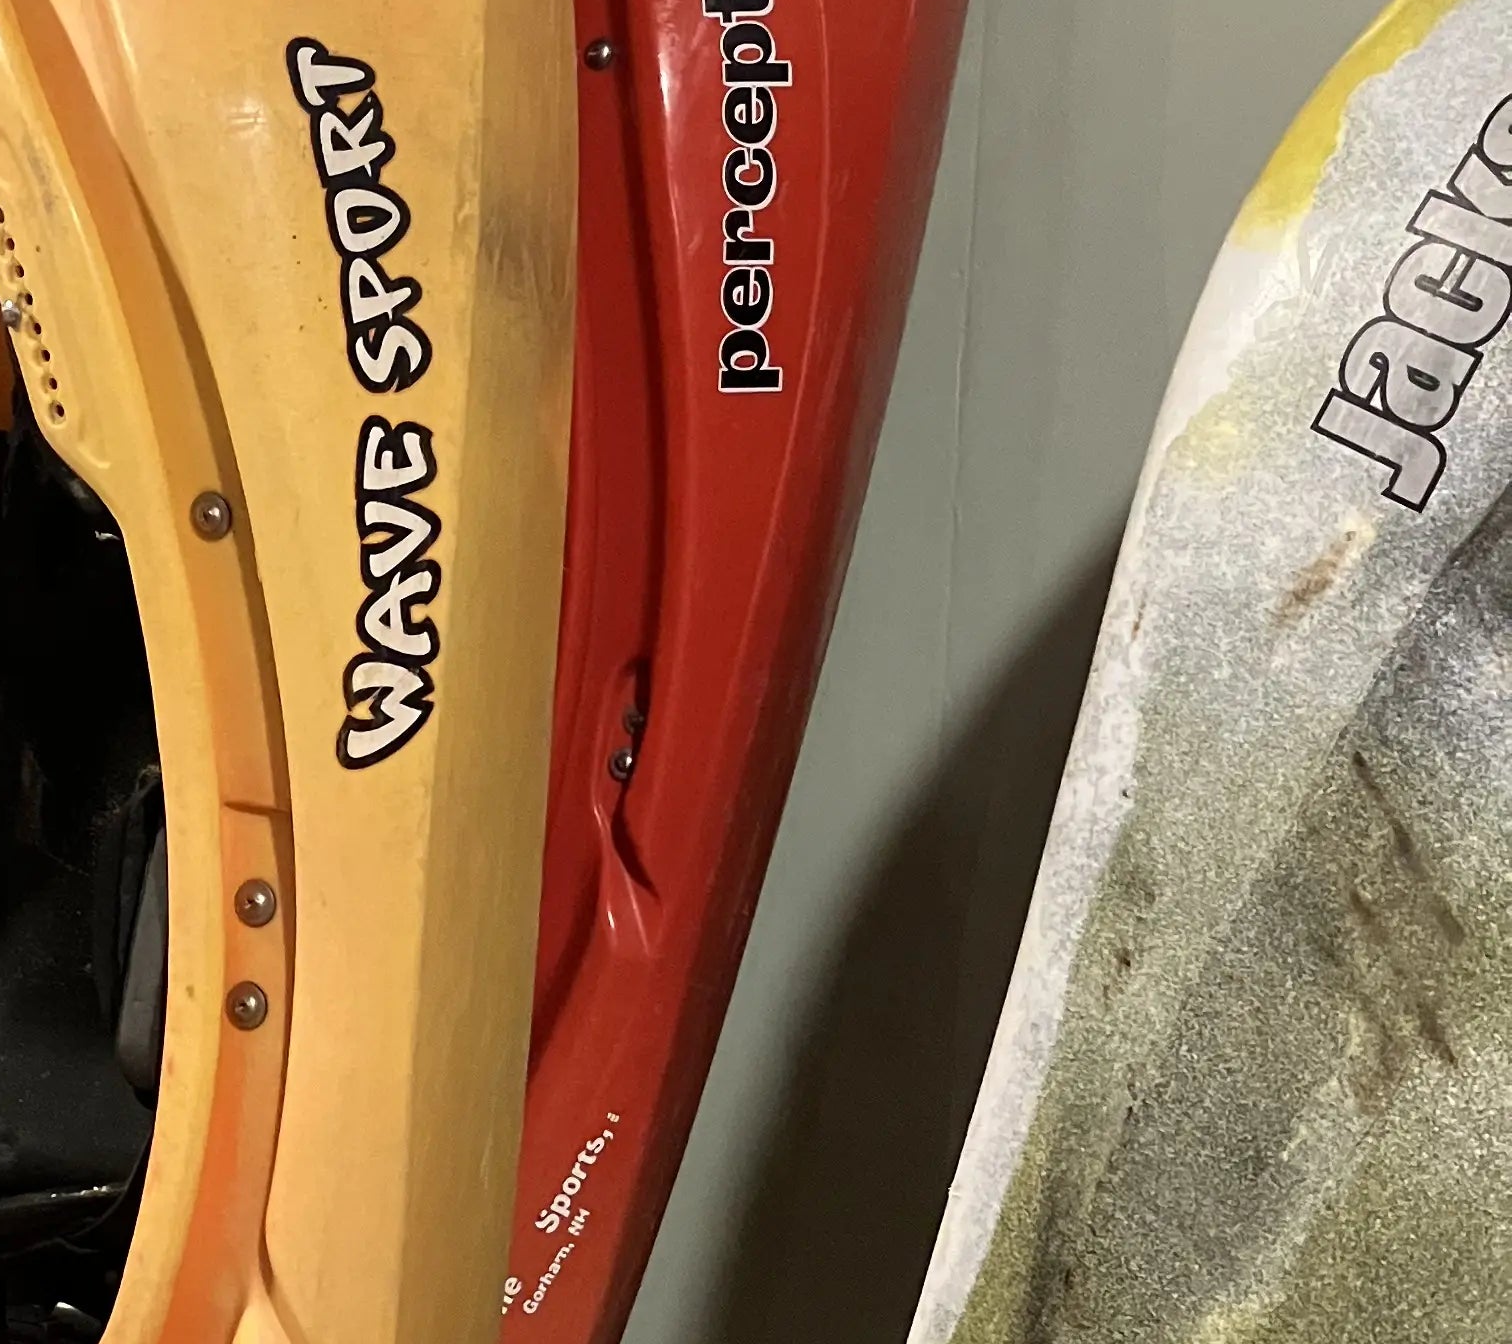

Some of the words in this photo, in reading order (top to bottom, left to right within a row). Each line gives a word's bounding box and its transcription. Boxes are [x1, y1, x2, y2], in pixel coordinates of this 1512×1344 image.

[288, 34, 434, 395] SPORT
[335, 413, 444, 772] WAVE
[522, 1242, 576, 1315] Gorham,
[534, 1128, 614, 1234] Sports,
